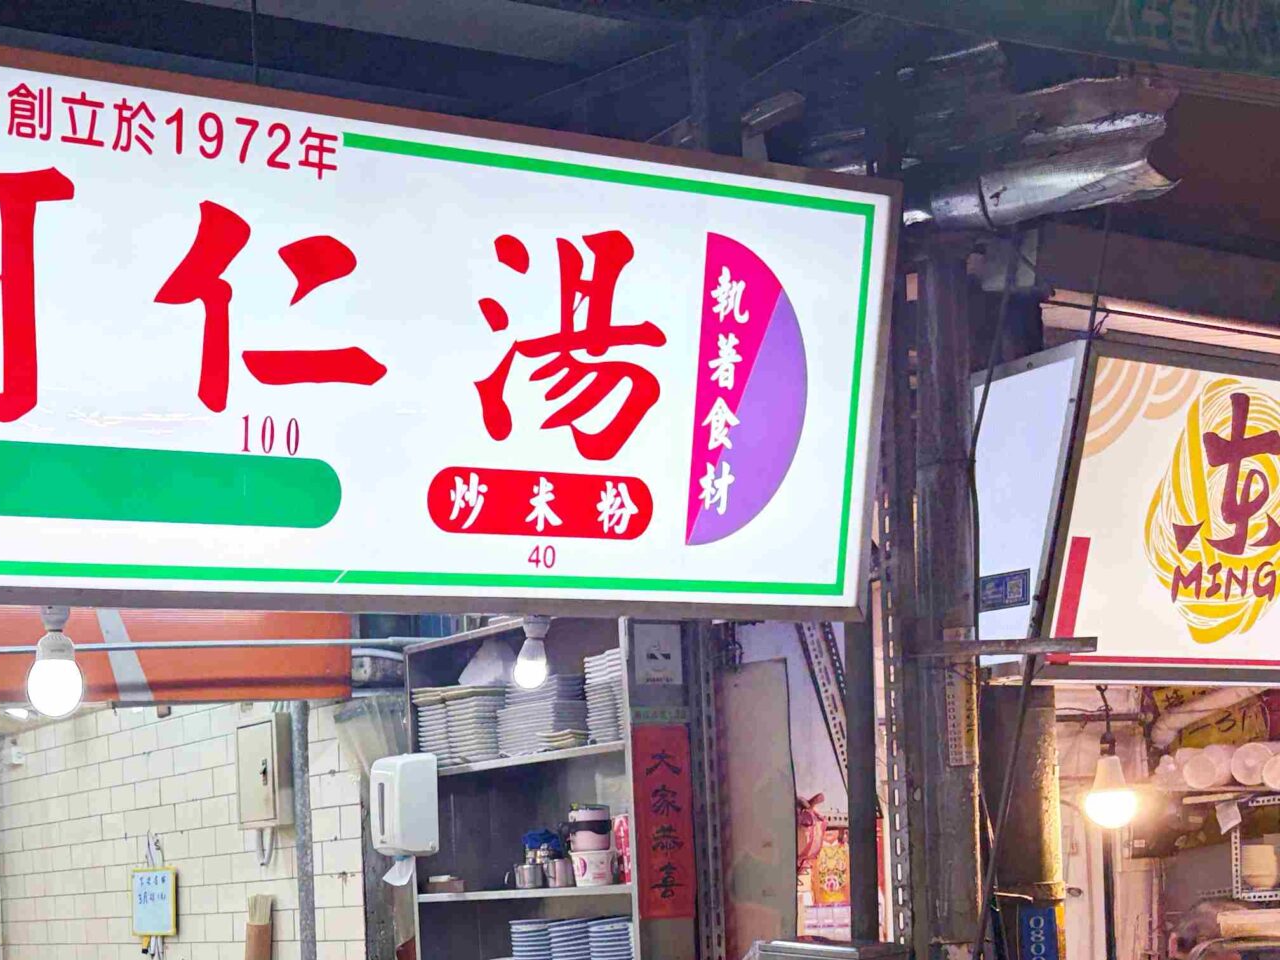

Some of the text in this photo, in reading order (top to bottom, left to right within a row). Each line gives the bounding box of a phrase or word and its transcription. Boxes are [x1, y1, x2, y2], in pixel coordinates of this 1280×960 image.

[241, 415, 300, 457] 100
[449, 472, 639, 534] 炒米粉
[527, 544, 557, 570] 40
[1171, 560, 1277, 604] MING
